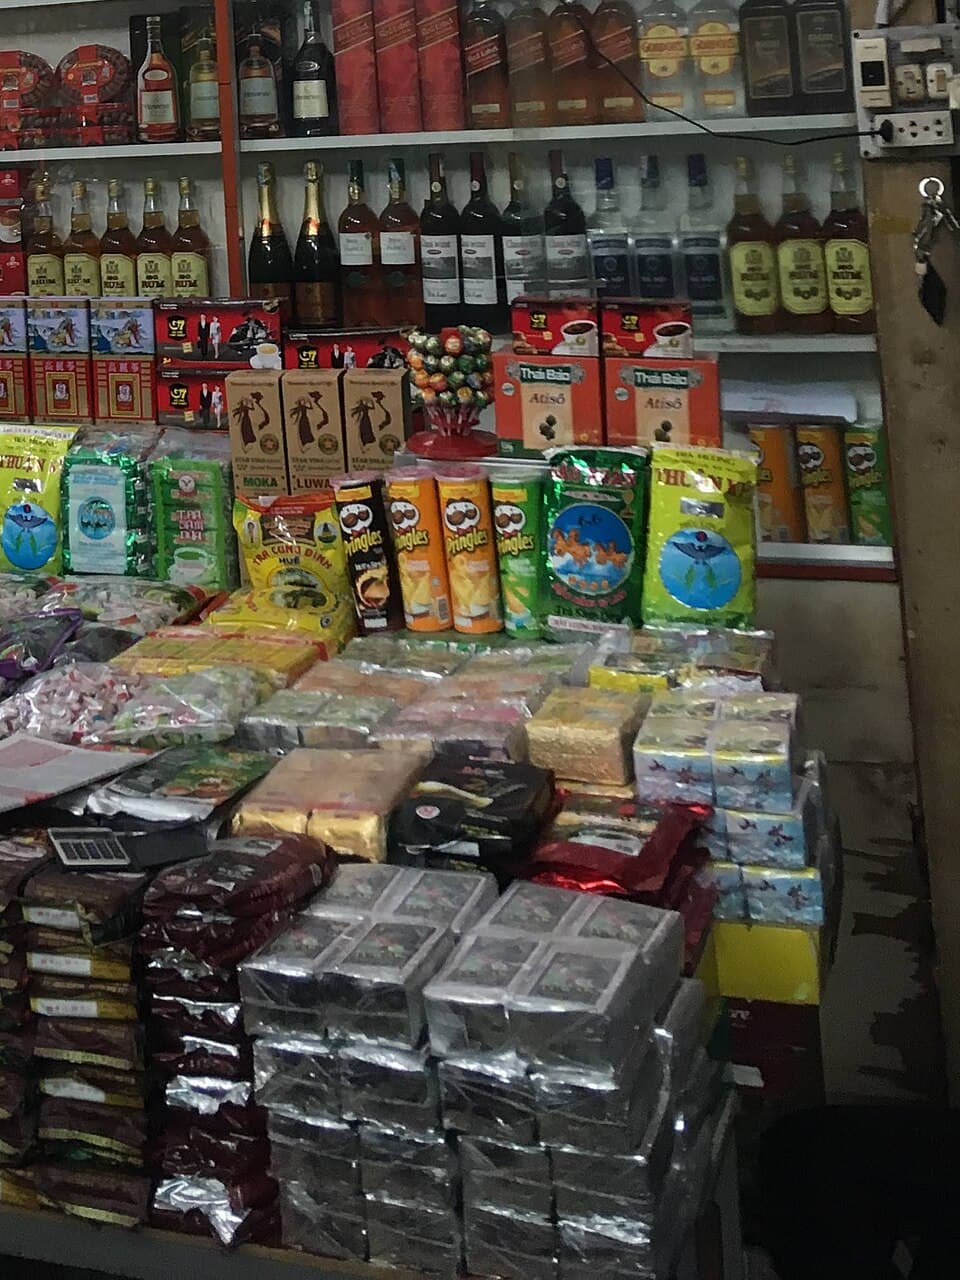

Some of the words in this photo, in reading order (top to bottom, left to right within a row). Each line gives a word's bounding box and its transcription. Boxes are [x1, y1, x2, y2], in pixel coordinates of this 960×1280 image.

[243, 477, 278, 488] MOKA
[297, 478, 333, 489] LUWA
[447, 529, 488, 553] Pringles
